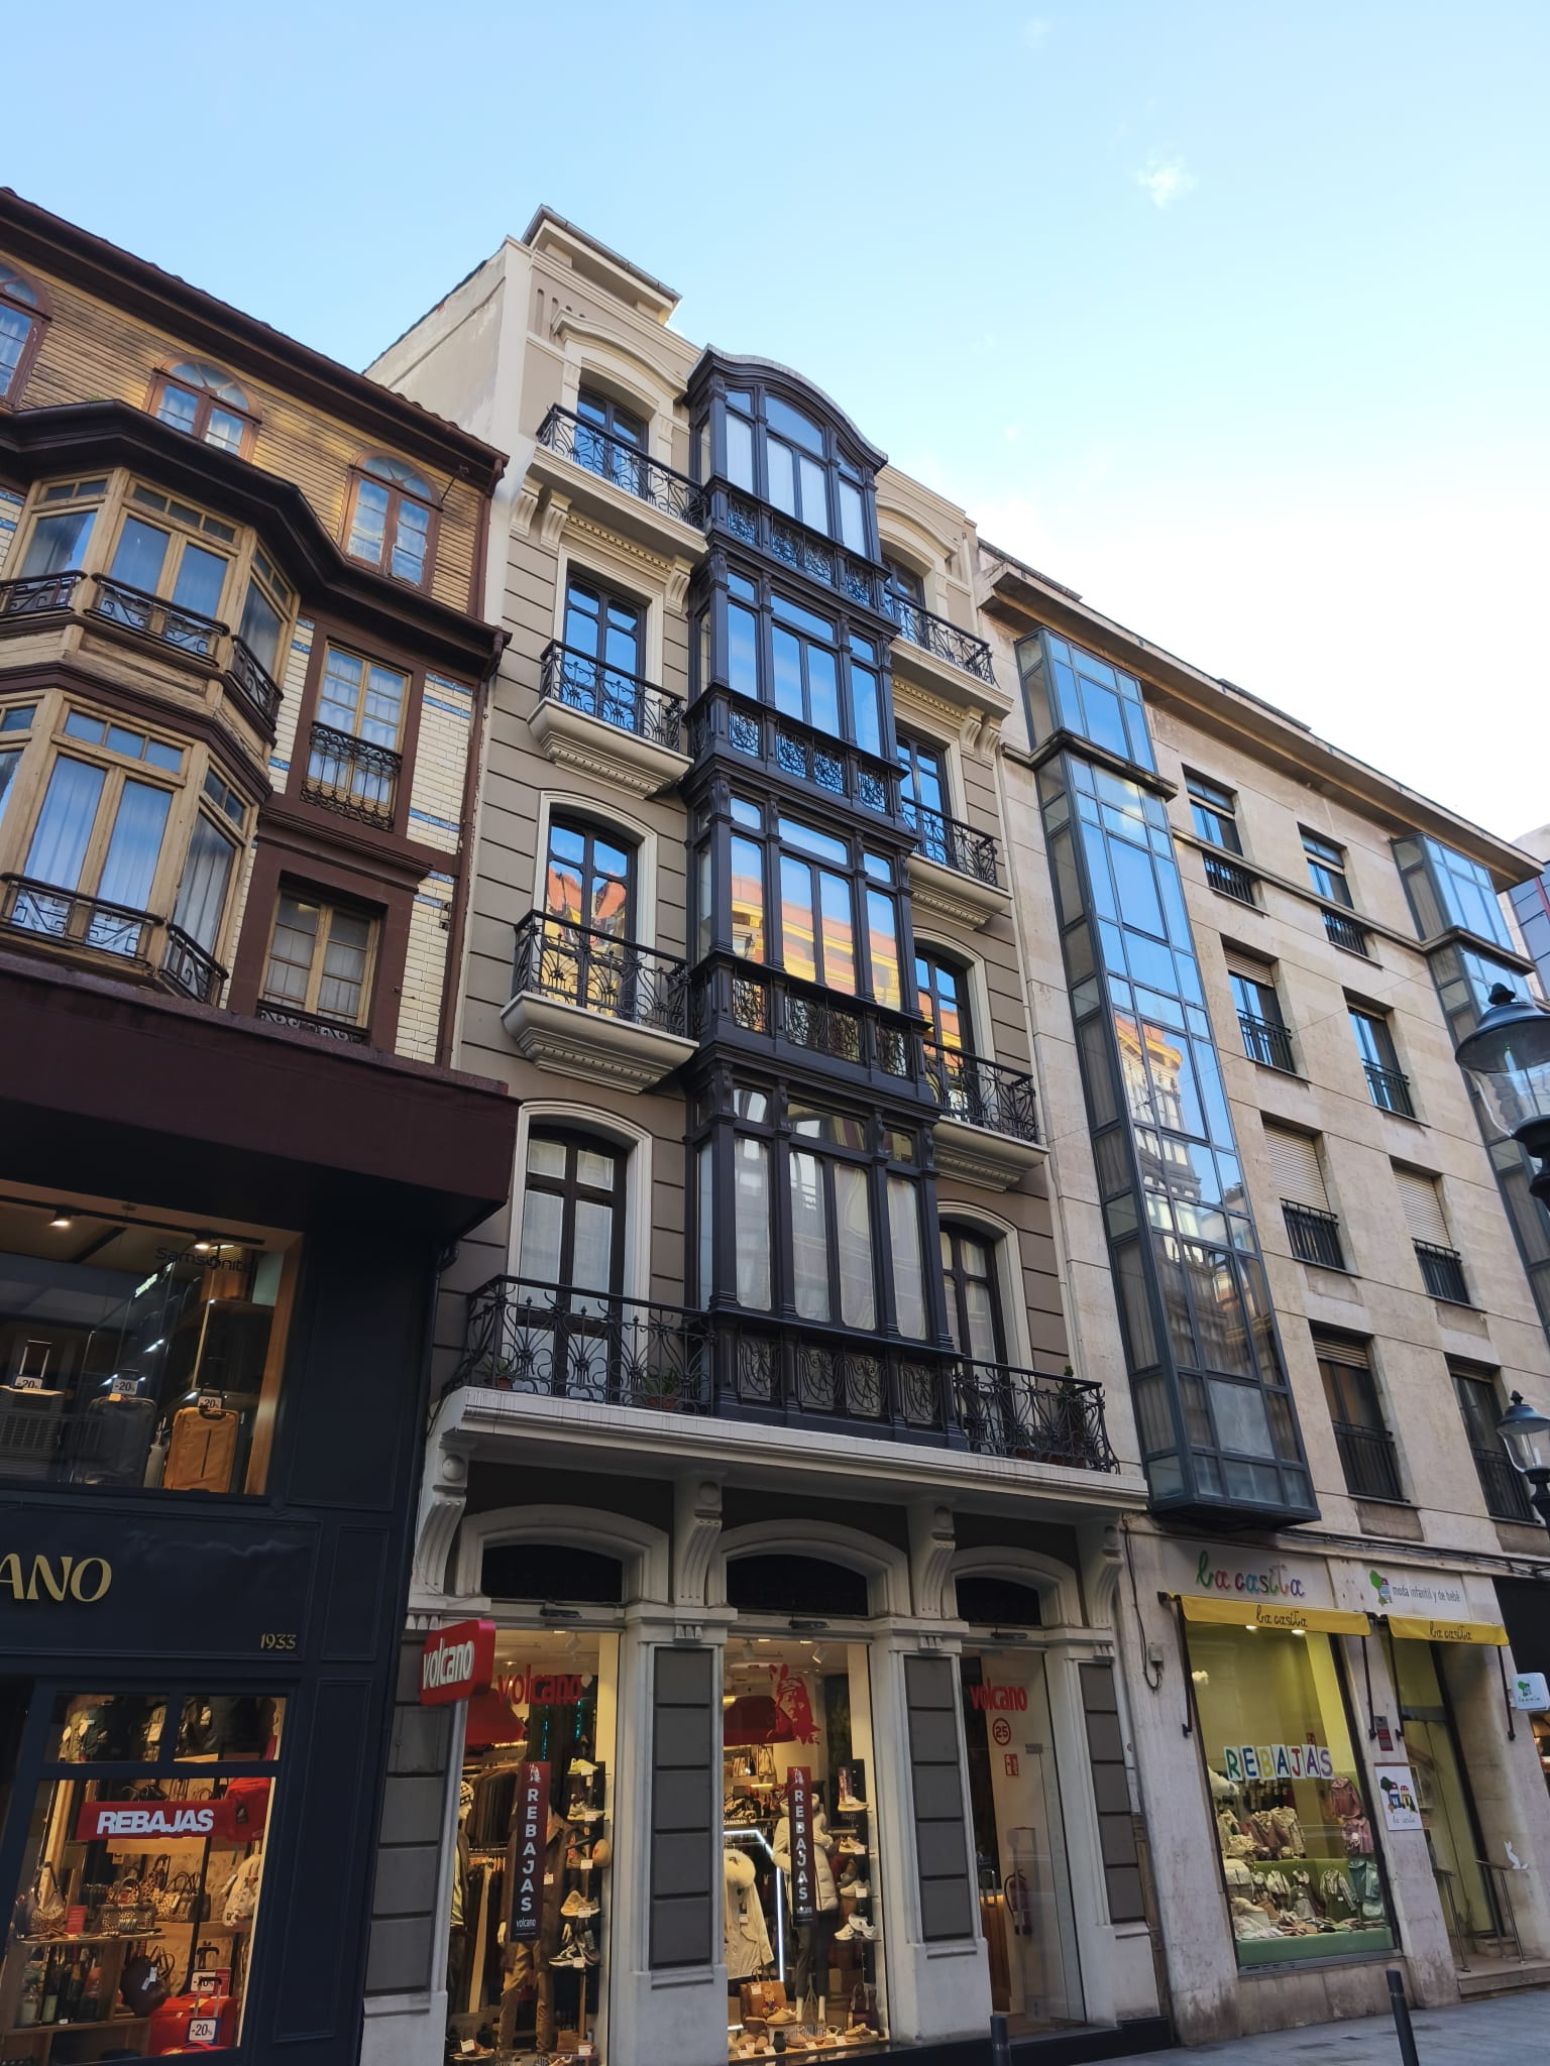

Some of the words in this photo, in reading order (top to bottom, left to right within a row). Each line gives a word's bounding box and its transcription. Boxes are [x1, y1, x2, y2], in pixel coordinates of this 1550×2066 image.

[0, 1552, 112, 1602] ANO
[1234, 1564, 1305, 1597] casita
[1392, 1584, 1410, 1598] moda
[1410, 1583, 1433, 1600] infantil
[1438, 1589, 1447, 1601] de
[1446, 1589, 1461, 1602] bebé
[1273, 1610, 1308, 1628] casita
[260, 1633, 297, 1650] 1933
[423, 1637, 475, 1690] volcano
[497, 1664, 583, 1706] volcano
[969, 1677, 1028, 1712] volcano
[995, 1725, 1009, 1739] 25
[1224, 1746, 1334, 1779] REBAJAS
[96, 1808, 215, 1834] REBAJAS
[520, 1787, 539, 1913] REBAJAS
[793, 1789, 809, 1901] REBAJAS
[515, 1917, 537, 1929] volcano
